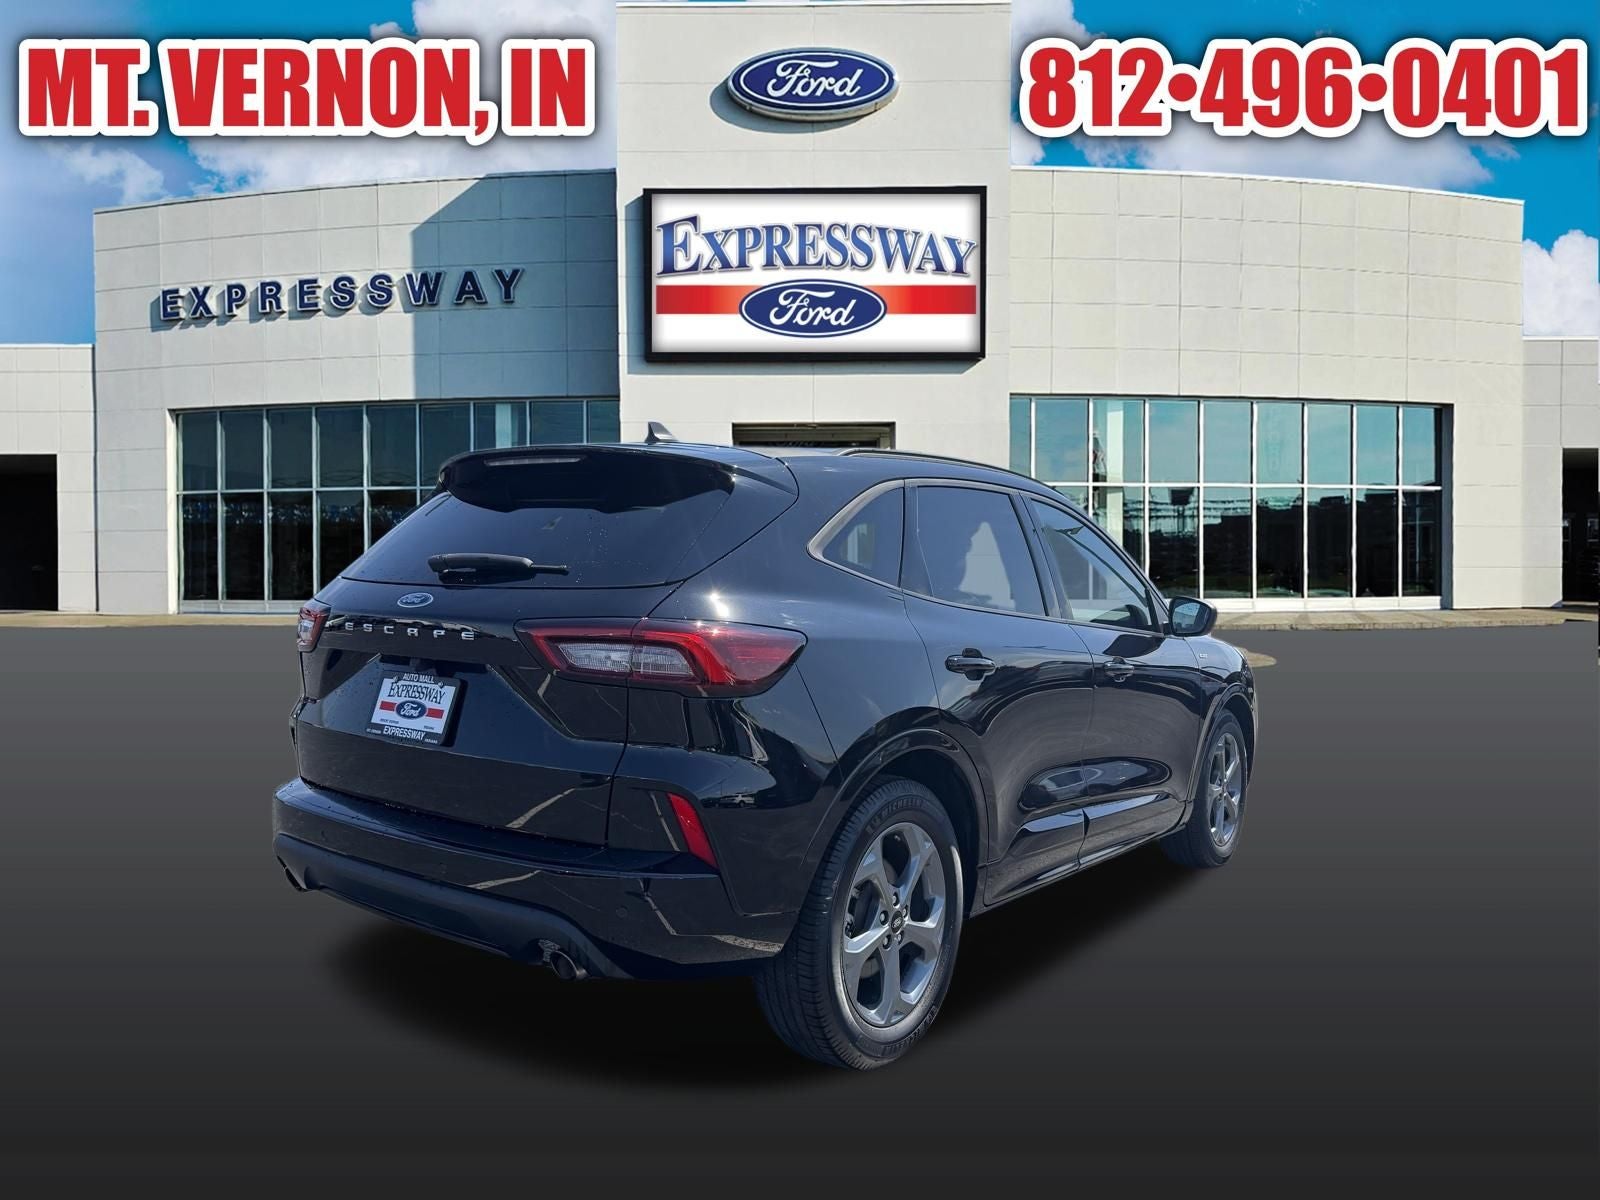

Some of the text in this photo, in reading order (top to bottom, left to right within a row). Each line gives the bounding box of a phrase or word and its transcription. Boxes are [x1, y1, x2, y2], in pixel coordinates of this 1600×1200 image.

[767, 60, 863, 97] Ford
[656, 213, 977, 278] EXPRESSWAY
[159, 268, 525, 322] EXPRESSWAY
[769, 288, 857, 326] Ford
[344, 621, 475, 641] ESCAPE
[402, 672, 435, 684] AUTO MALL
[387, 681, 446, 705] EXPRESSWAY
[400, 702, 422, 717] Ford
[382, 725, 426, 741] EXPRESSWAY
